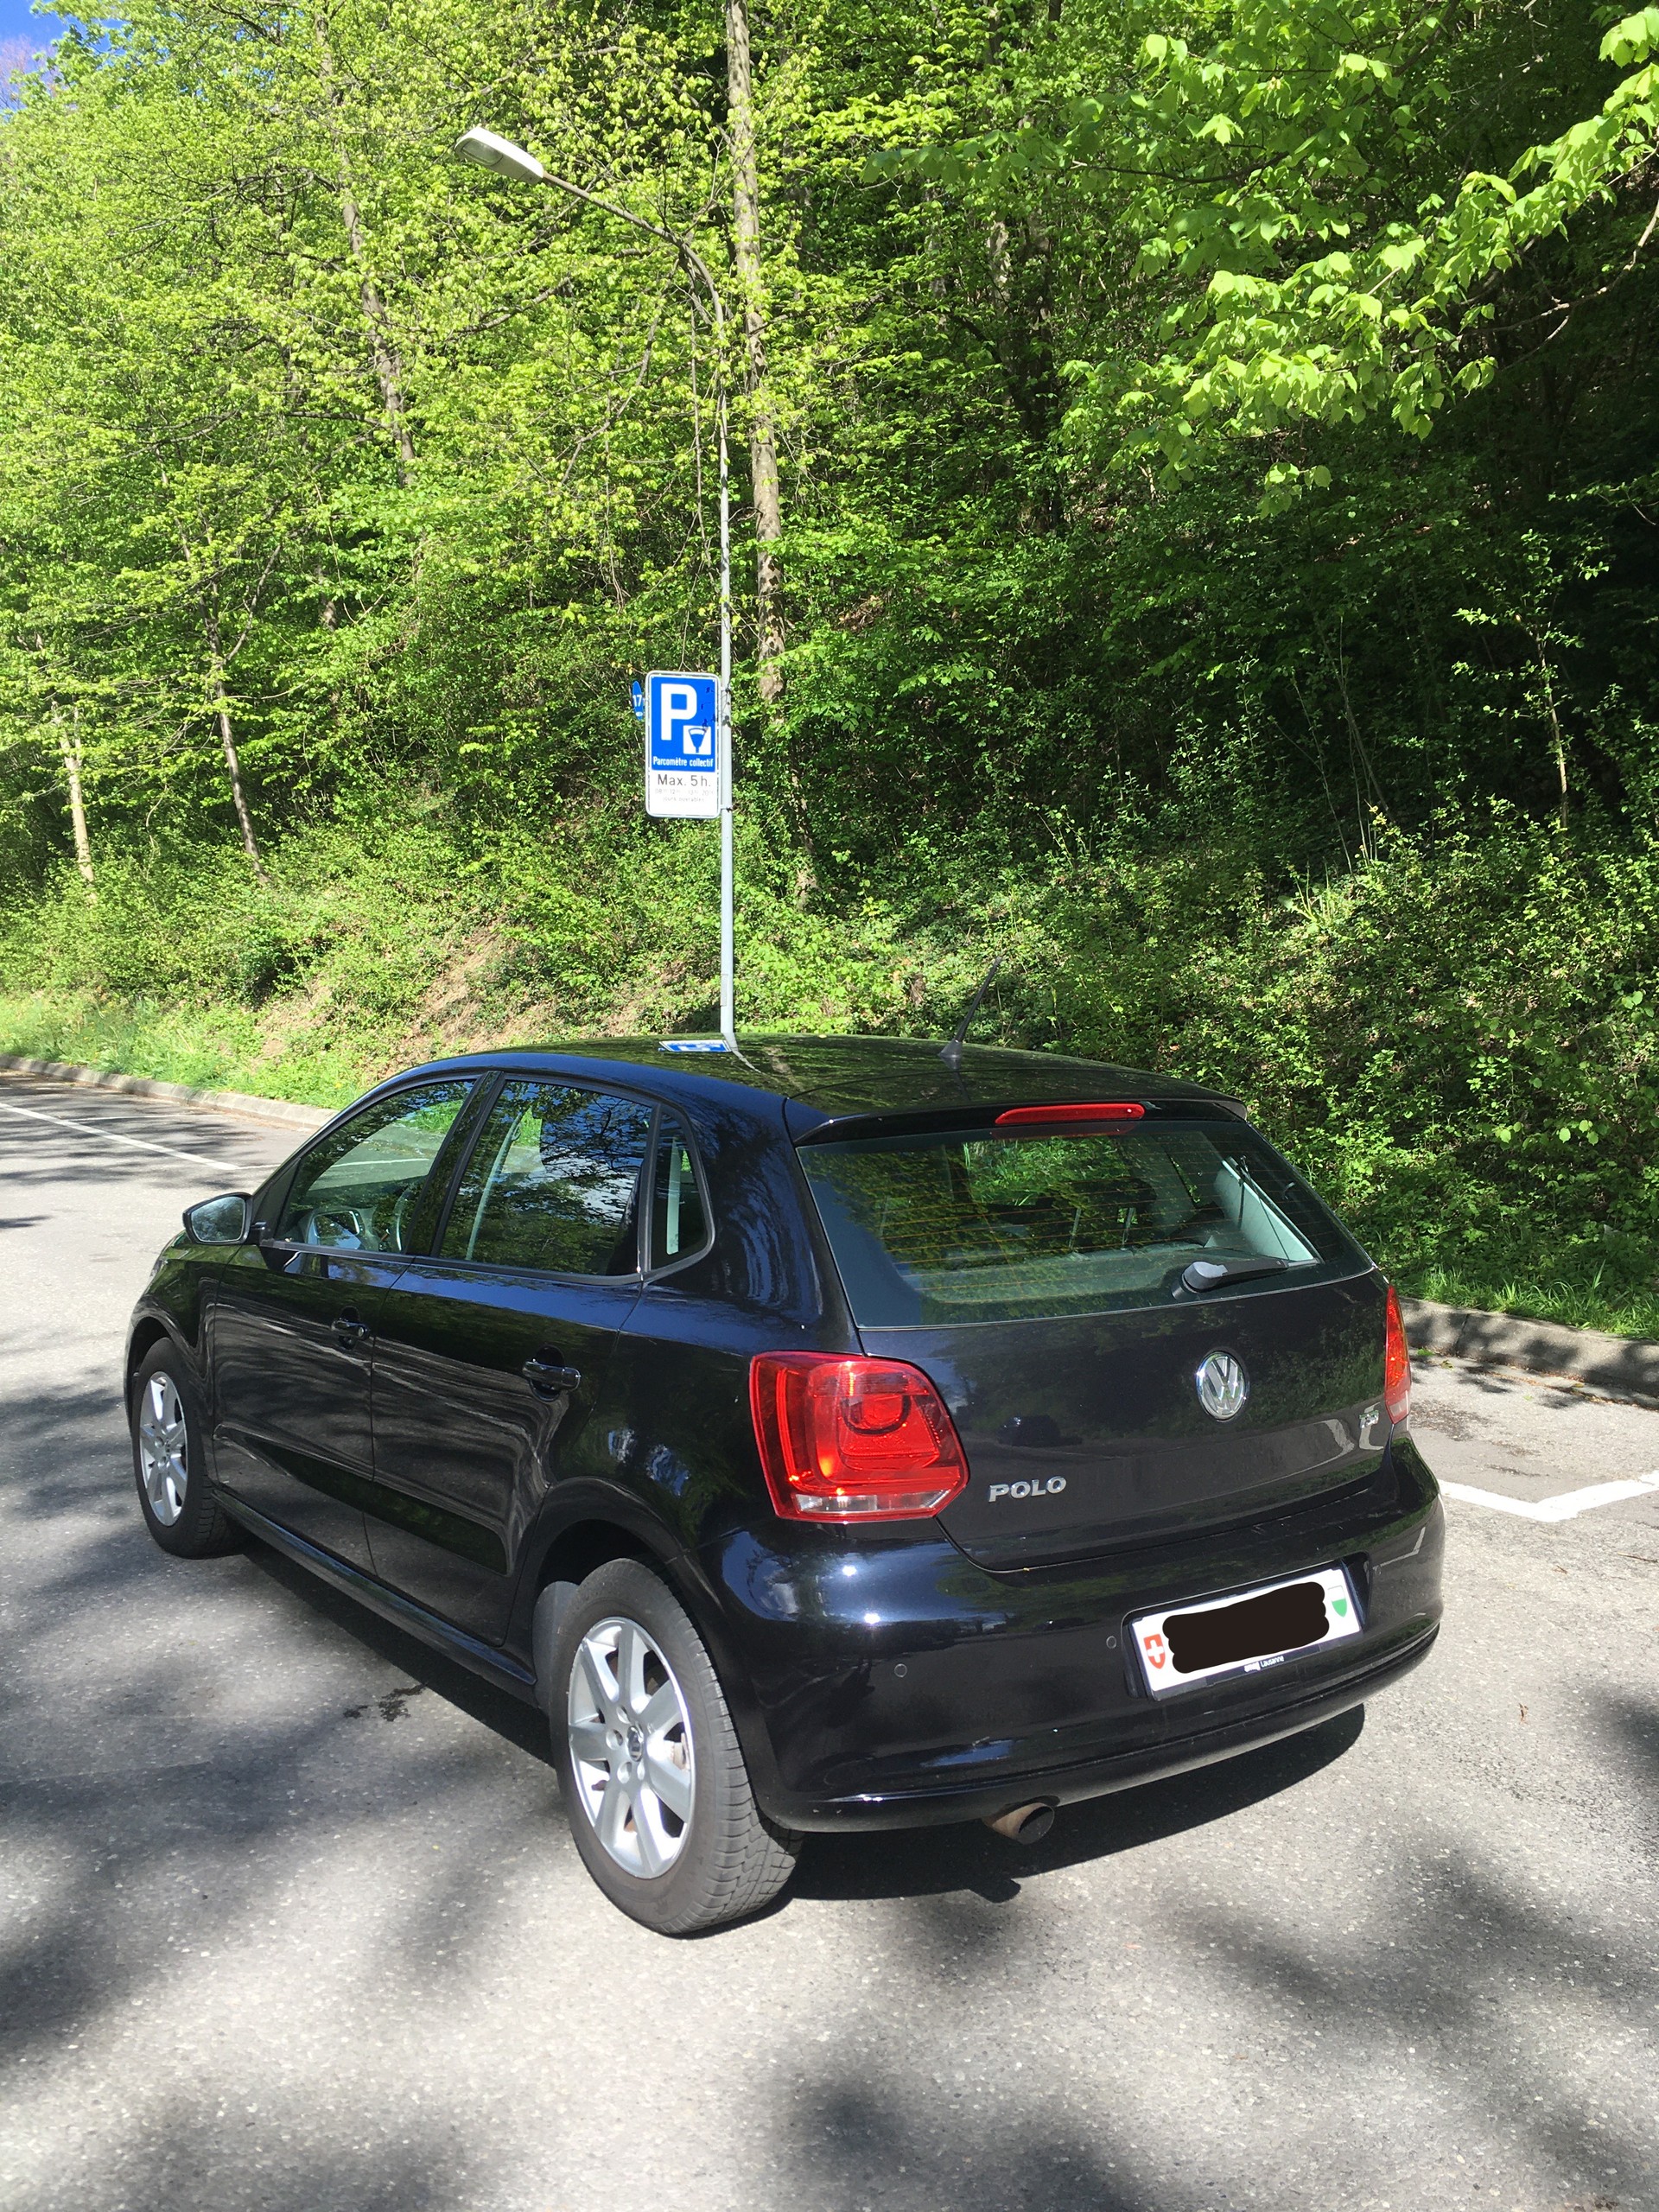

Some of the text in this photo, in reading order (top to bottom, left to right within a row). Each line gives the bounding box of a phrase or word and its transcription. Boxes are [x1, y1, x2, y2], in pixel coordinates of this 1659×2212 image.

[632, 695, 642, 707] 17
[661, 683, 697, 741] P
[652, 756, 714, 767] Parcomètre collectif
[658, 774, 686, 785] Max.
[988, 1476, 1067, 1503] POLO
